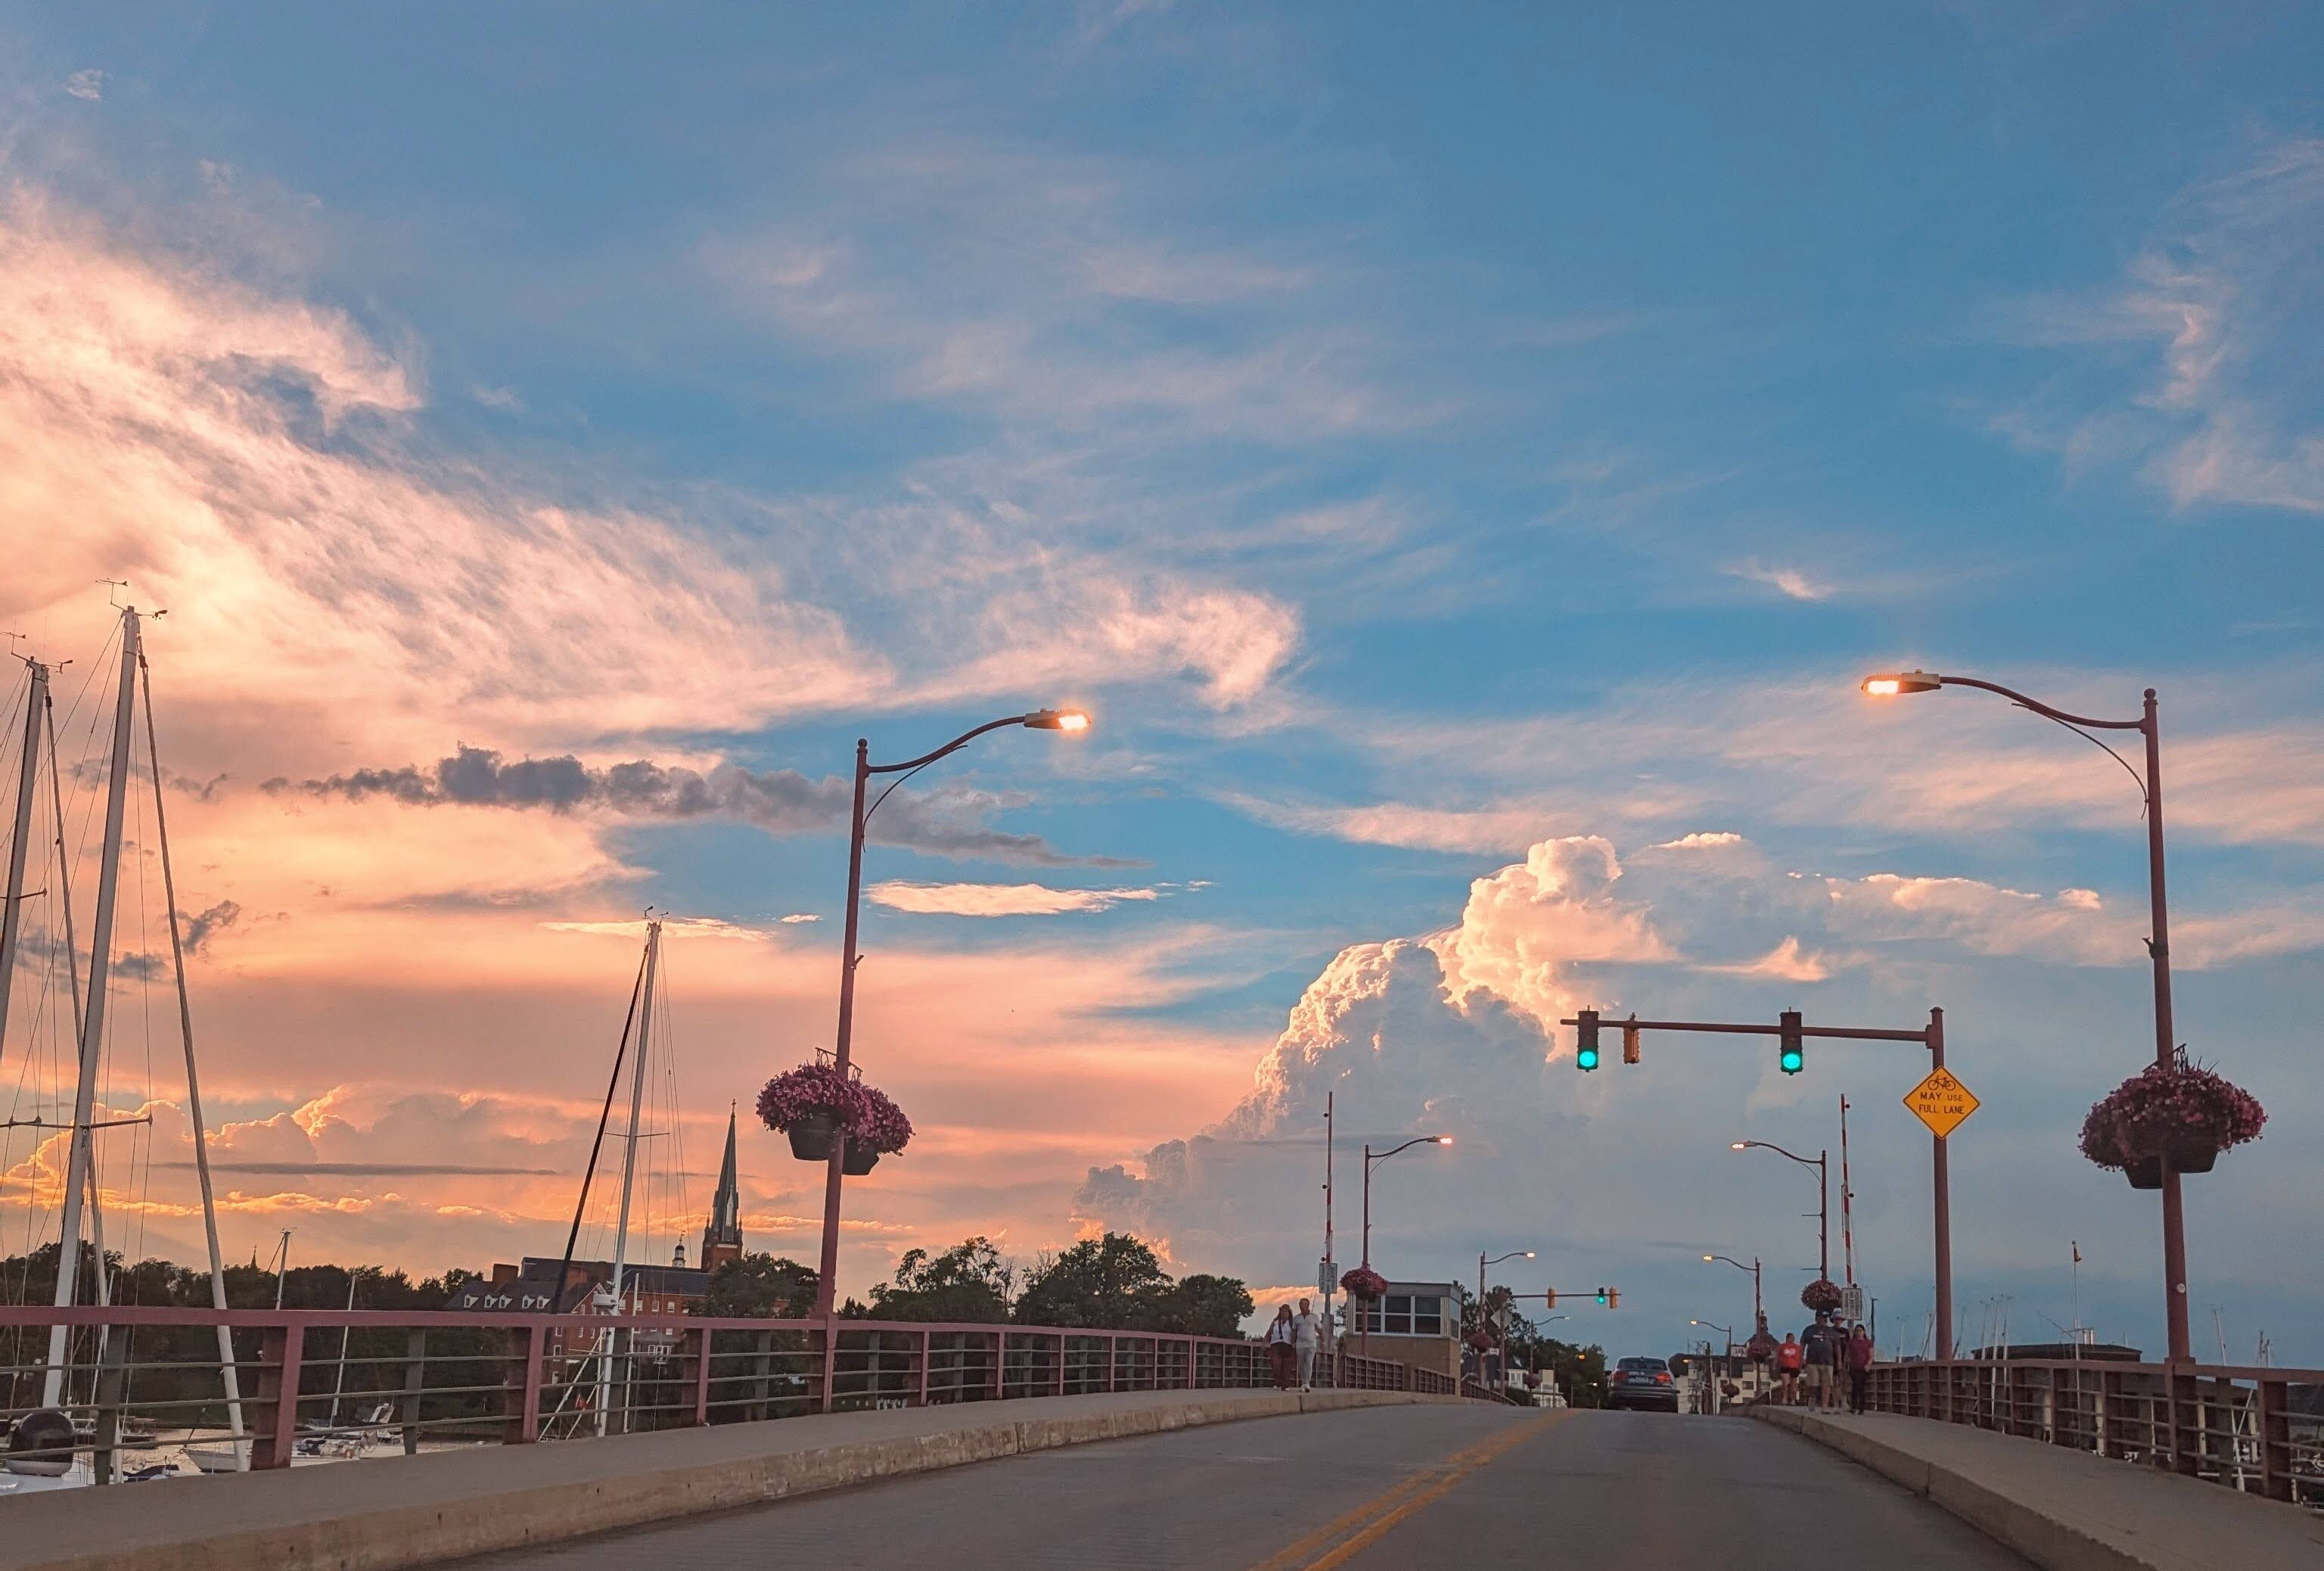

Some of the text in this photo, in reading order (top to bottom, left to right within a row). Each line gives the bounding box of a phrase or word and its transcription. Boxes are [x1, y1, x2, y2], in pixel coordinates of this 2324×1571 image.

[1920, 1092, 1942, 1100] MAY
[1919, 1104, 1965, 1115] FULL LANE
